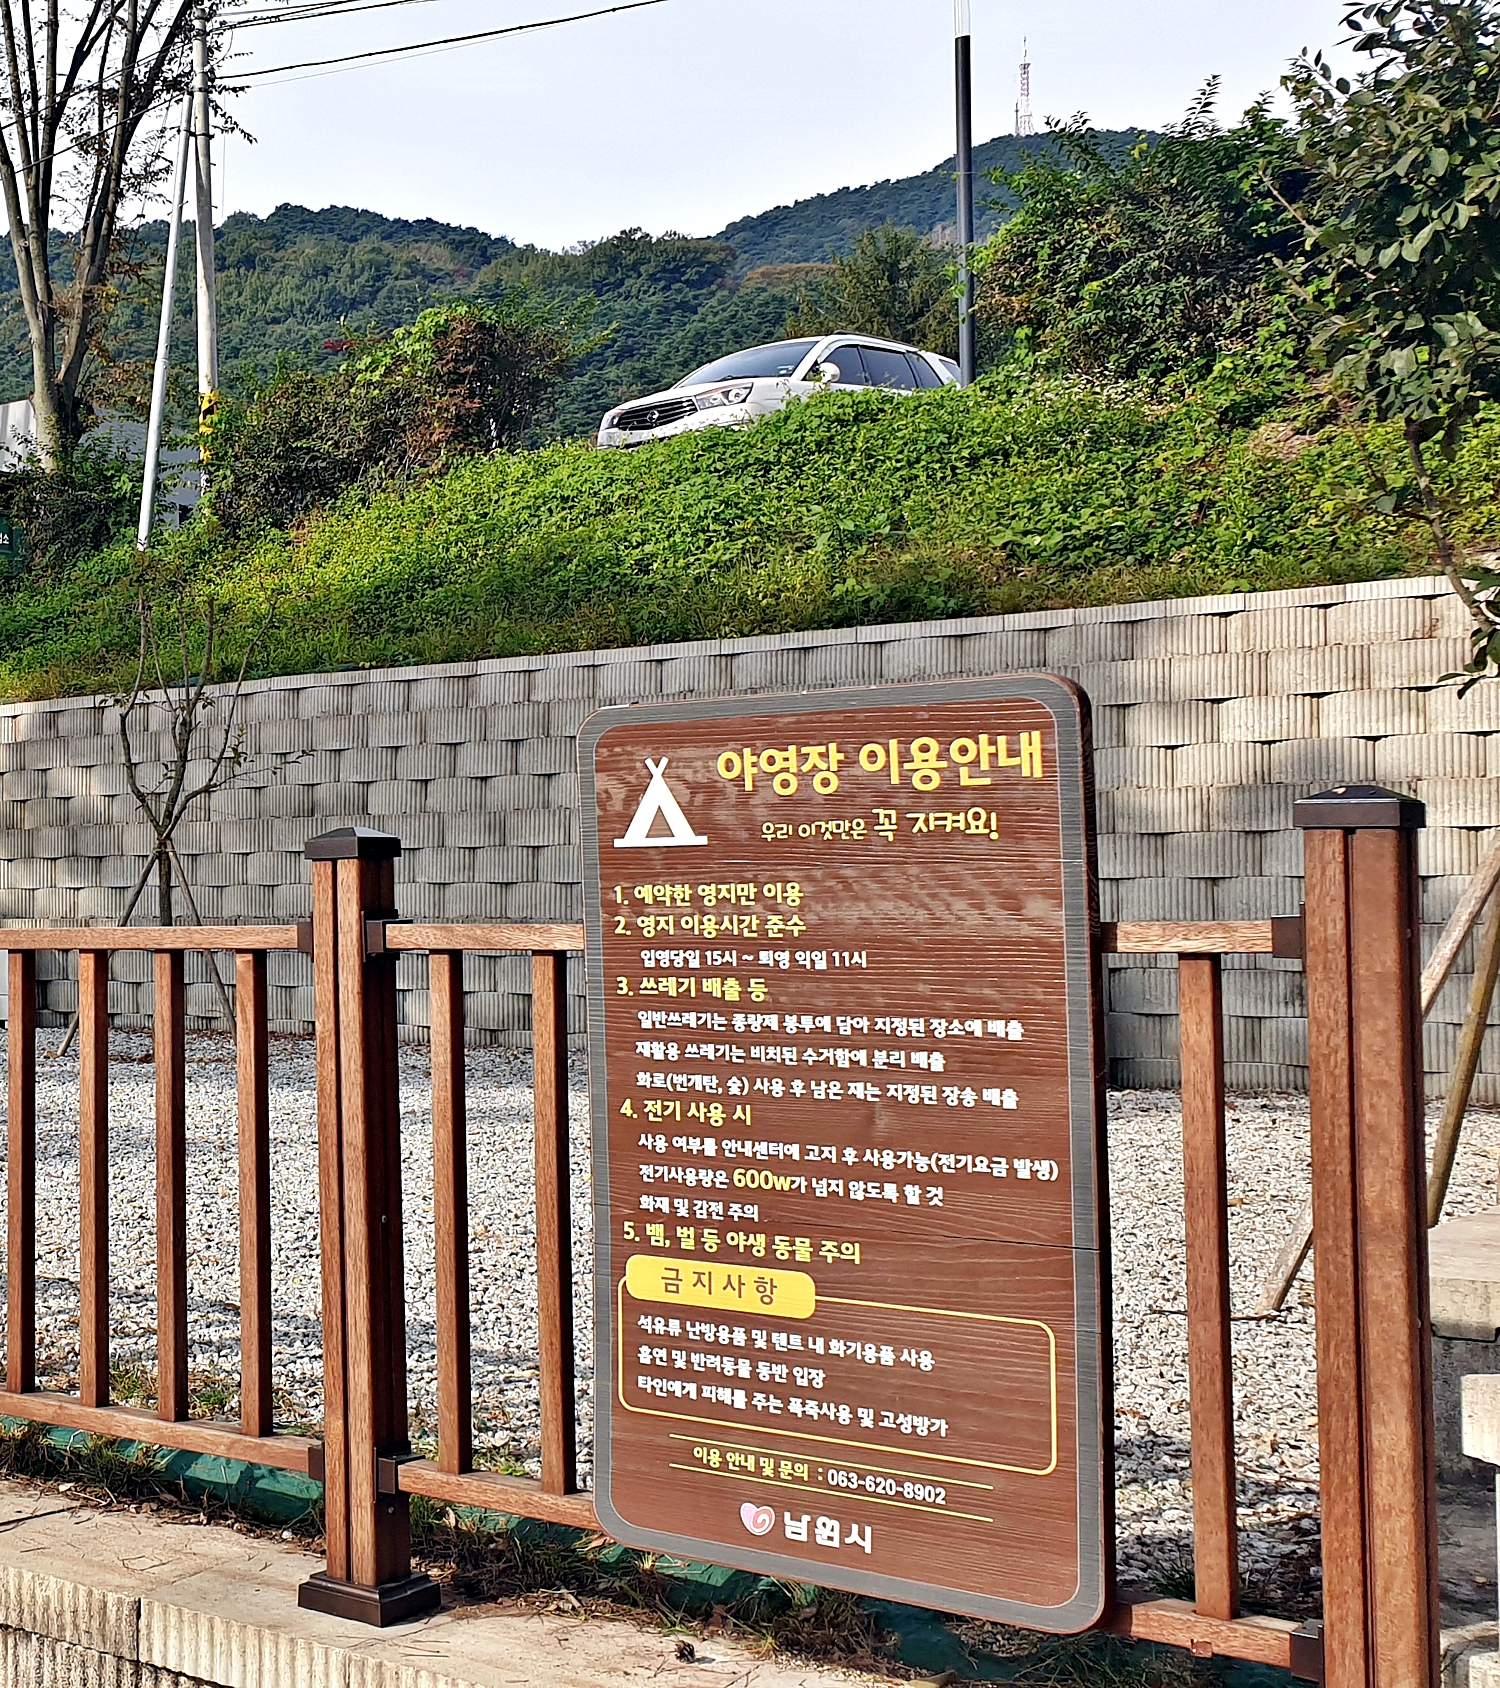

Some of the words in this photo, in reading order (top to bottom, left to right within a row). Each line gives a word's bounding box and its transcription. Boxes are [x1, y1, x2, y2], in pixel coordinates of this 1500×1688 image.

[717, 743, 845, 796] 야영장
[858, 731, 1043, 791] 이용안내
[760, 820, 793, 842] 우리
[798, 819, 868, 840] 이것만은
[871, 808, 898, 842] 꼭
[905, 807, 999, 840] 지켜요!
[614, 885, 629, 905] 1.
[633, 884, 692, 906] 예약한
[697, 882, 758, 906] 영지만
[762, 882, 804, 906] 이용
[614, 916, 632, 936] 2.
[637, 915, 675, 938] 영지
[680, 915, 760, 938] 이용시간
[764, 915, 807, 938] 준수
[640, 950, 701, 969] 입영당일
[704, 950, 737, 967] 15시
[757, 950, 790, 969] 퇴영
[794, 951, 827, 970] 익일
[831, 951, 867, 968] 11시
[616, 976, 634, 996] 3.
[639, 977, 696, 997] 쓰레기
[702, 977, 742, 1001] 배출
[747, 978, 768, 1002] 등
[637, 1011, 728, 1031] 일반쓰레기는
[783, 1014, 831, 1034] 봉투에
[835, 1016, 870, 1035] 담아
[874, 1017, 925, 1038] 지정된
[929, 1018, 982, 1038] 장소에
[987, 1019, 1024, 1040] 배출
[635, 1041, 681, 1061] 재활용
[684, 1044, 746, 1063] 쓰레기는
[750, 1045, 798, 1065] 비치된
[802, 1047, 867, 1068] 수거함에
[872, 1049, 906, 1069] 분리
[910, 1051, 946, 1072] 배출
[636, 1071, 723, 1094] 화로(번개탄,
[726, 1076, 750, 1095] 숯)
[753, 1078, 786, 1098] 사용
[789, 1079, 806, 1097] 후
[810, 1080, 844, 1100] 남은
[847, 1082, 882, 1102] 재는
[886, 1083, 938, 1105] 지정된
[941, 1085, 978, 1107] 장송
[982, 1088, 1019, 1110] 배출
[620, 1098, 638, 1119] 4.
[643, 1099, 681, 1122] 전기
[687, 1102, 726, 1127] 사용
[732, 1104, 752, 1126] 시
[638, 1133, 668, 1153] 사용
[672, 1136, 718, 1157] 여부를
[721, 1139, 800, 1161] 안내센터에
[804, 1144, 837, 1163] 고지
[841, 1147, 859, 1166] 후
[863, 1148, 1009, 1178] 사용가능(전기요금
[1013, 1158, 1059, 1181] 발생)
[639, 1164, 729, 1189] 전기사용량은
[733, 1168, 808, 1194] 600w가
[812, 1177, 844, 1197] 넘지
[848, 1180, 899, 1203] 않도록
[903, 1184, 922, 1205] 할
[926, 1185, 944, 1207] 것
[639, 1195, 670, 1213] 화재
[674, 1198, 689, 1217] 및
[693, 1200, 724, 1220] 감전
[727, 1203, 759, 1222] 주의
[623, 1221, 640, 1242] 5.
[645, 1223, 671, 1248] 뱀,
[676, 1226, 695, 1250] 벌
[701, 1228, 720, 1253] 등
[726, 1231, 766, 1257] 야생
[772, 1235, 813, 1263] 동물
[819, 1240, 860, 1265] 주의
[661, 1267, 777, 1306] 금지사항
[637, 1315, 682, 1336] 석유류
[686, 1321, 747, 1347] 난방용품
[751, 1329, 767, 1349] 및
[771, 1332, 804, 1352] 텐트
[808, 1336, 825, 1355] 내
[828, 1339, 896, 1366] 화기용품
[900, 1348, 935, 1371] 사용
[637, 1345, 667, 1366] 흡연
[671, 1350, 687, 1370] 및
[690, 1353, 752, 1379] 반려동물
[756, 1360, 789, 1383] 동반
[793, 1366, 826, 1389] 입장
[637, 1375, 697, 1400] 타인에게
[701, 1384, 747, 1409] 피해를
[751, 1392, 784, 1414] 주는
[857, 1407, 874, 1429] 및
[878, 1410, 948, 1437] 고성방가
[693, 1446, 722, 1467] 이용
[726, 1451, 755, 1472] 안내
[760, 1457, 775, 1477] 및
[778, 1460, 809, 1481] 문의
[827, 1468, 946, 1505] 063-620-8902
[784, 1511, 872, 1554] 남원시
